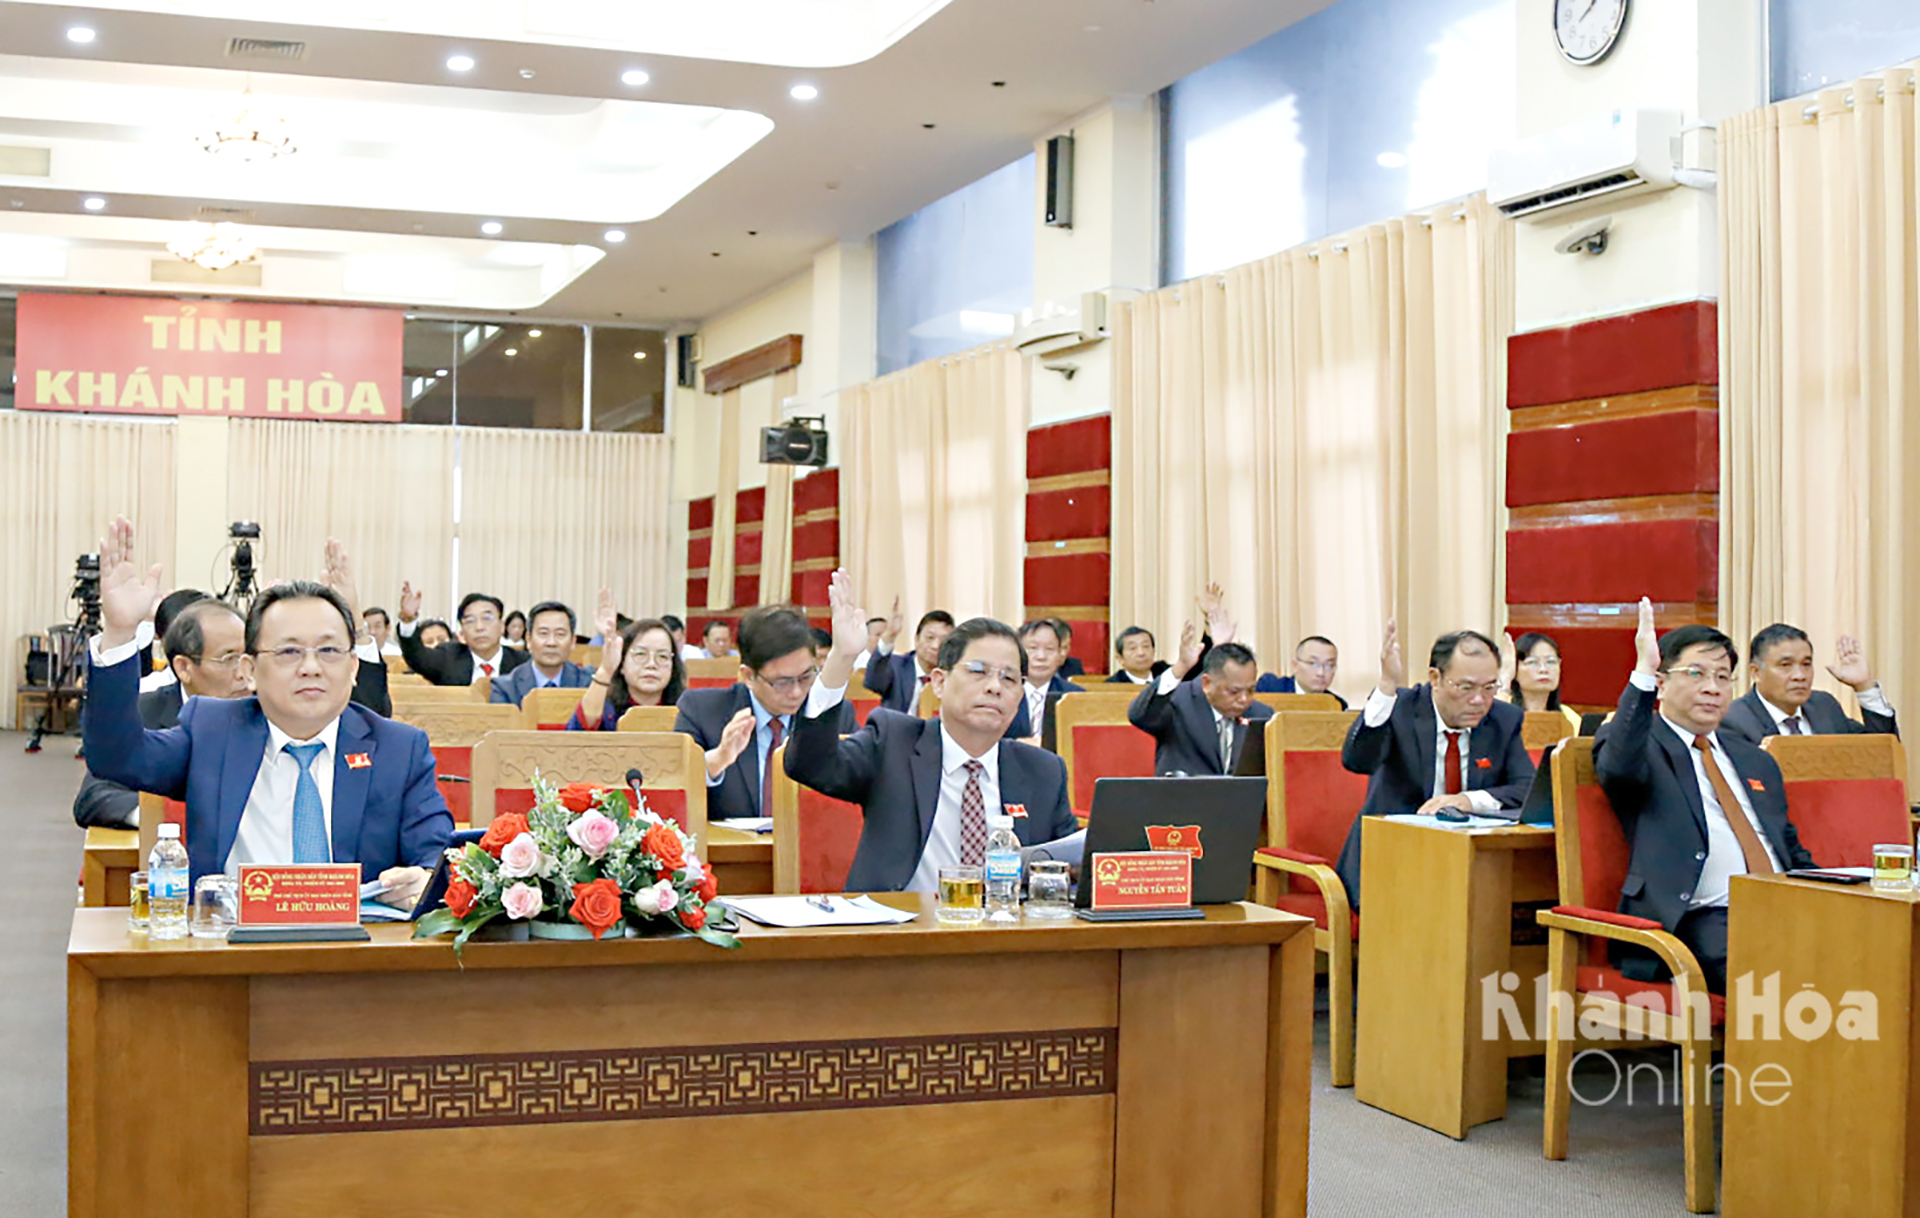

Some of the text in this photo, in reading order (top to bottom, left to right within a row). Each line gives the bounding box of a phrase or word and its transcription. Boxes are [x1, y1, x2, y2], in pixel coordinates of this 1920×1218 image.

[143, 305, 283, 354] TỈNH
[35, 366, 386, 416] KHÁNH HÒA
[276, 900, 350, 912] LÊ HỮU HOÀNG
